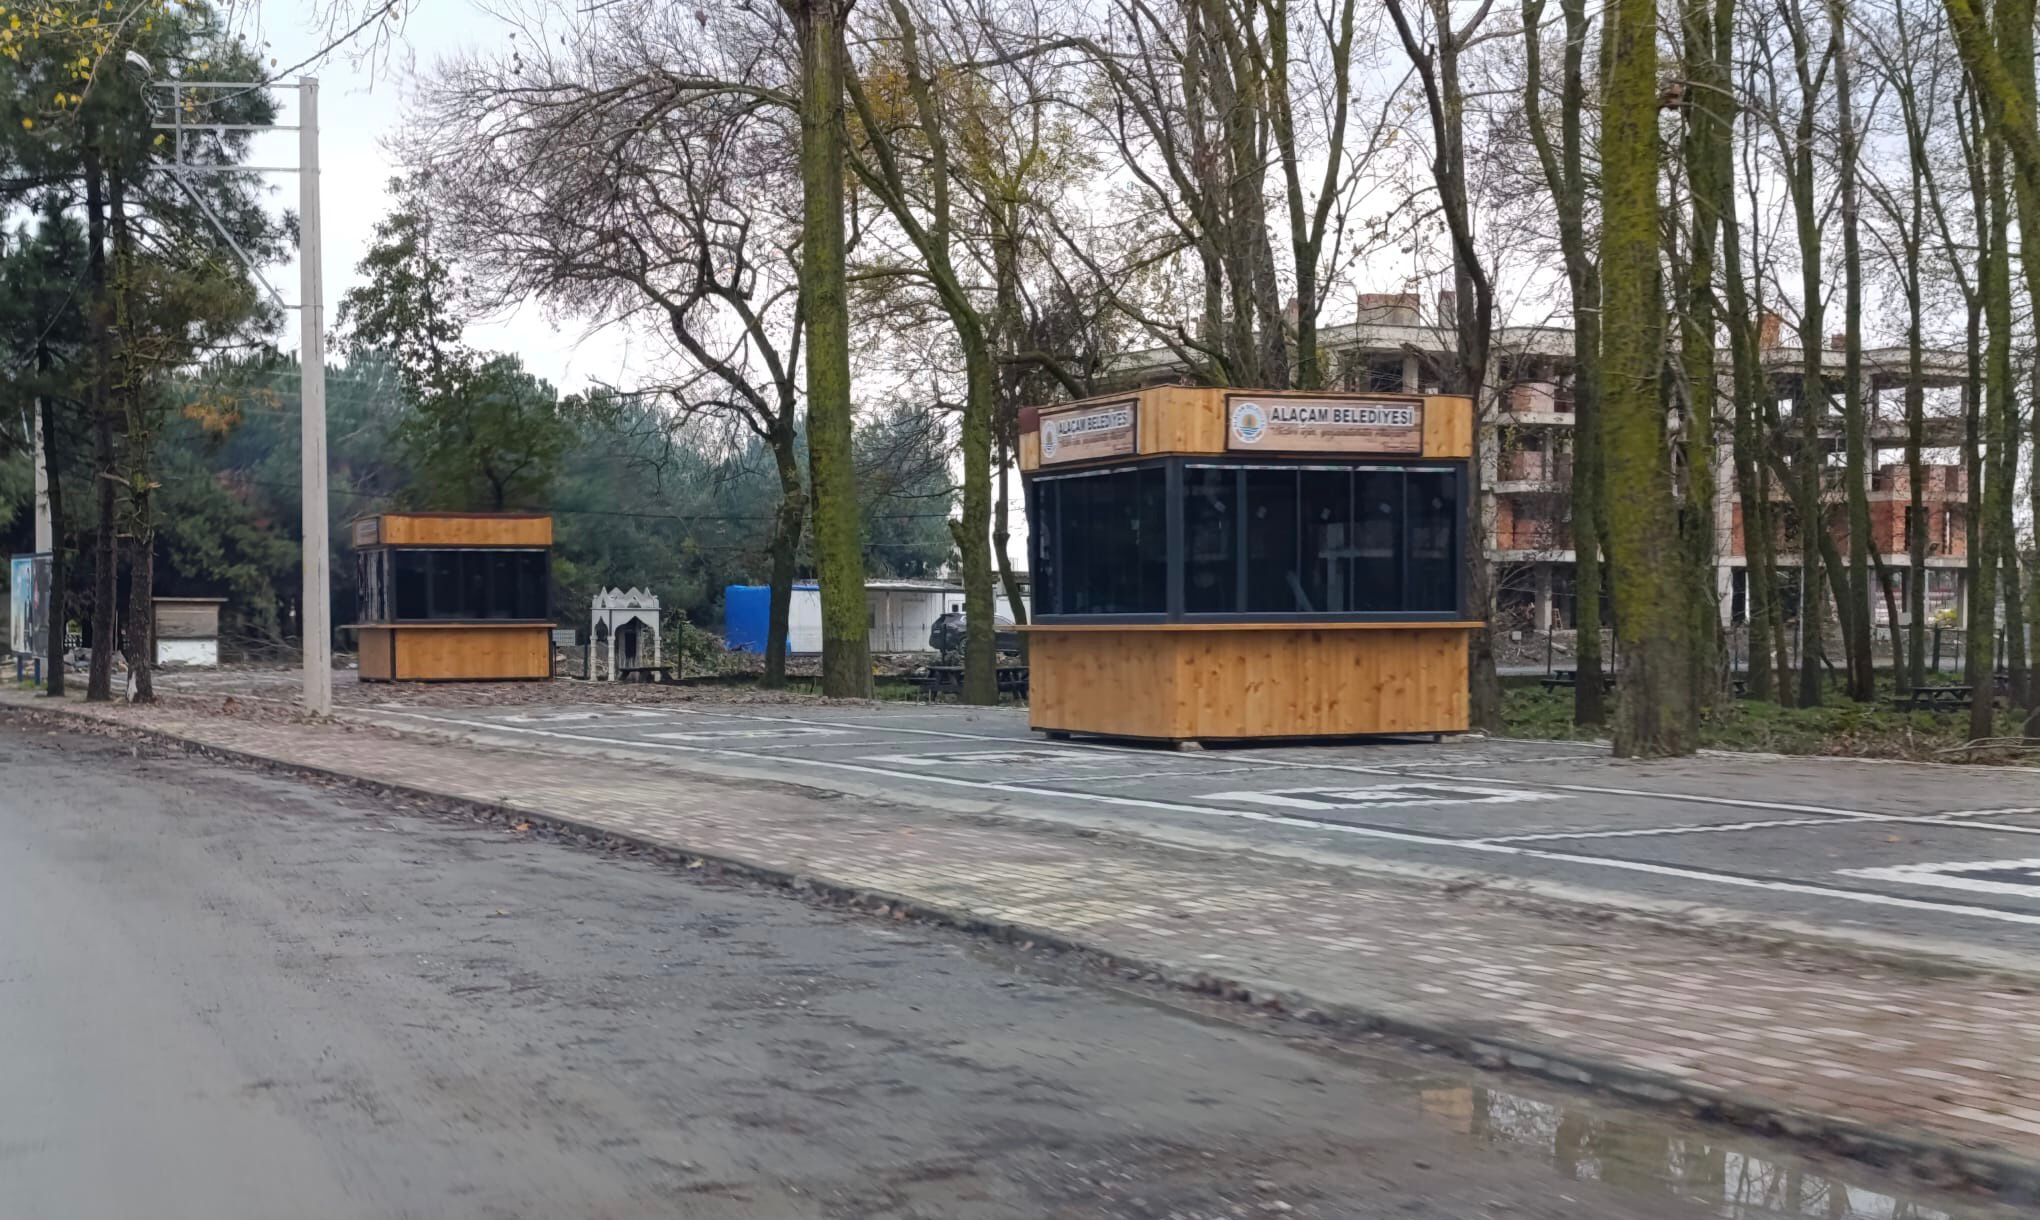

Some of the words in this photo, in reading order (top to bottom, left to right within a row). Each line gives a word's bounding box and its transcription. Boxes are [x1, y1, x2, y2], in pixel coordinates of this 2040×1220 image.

[1271, 407, 1328, 424] ALAÇAM
[1333, 405, 1413, 425] BELEDİYESİ
[1058, 418, 1087, 435] ALAÇAM
